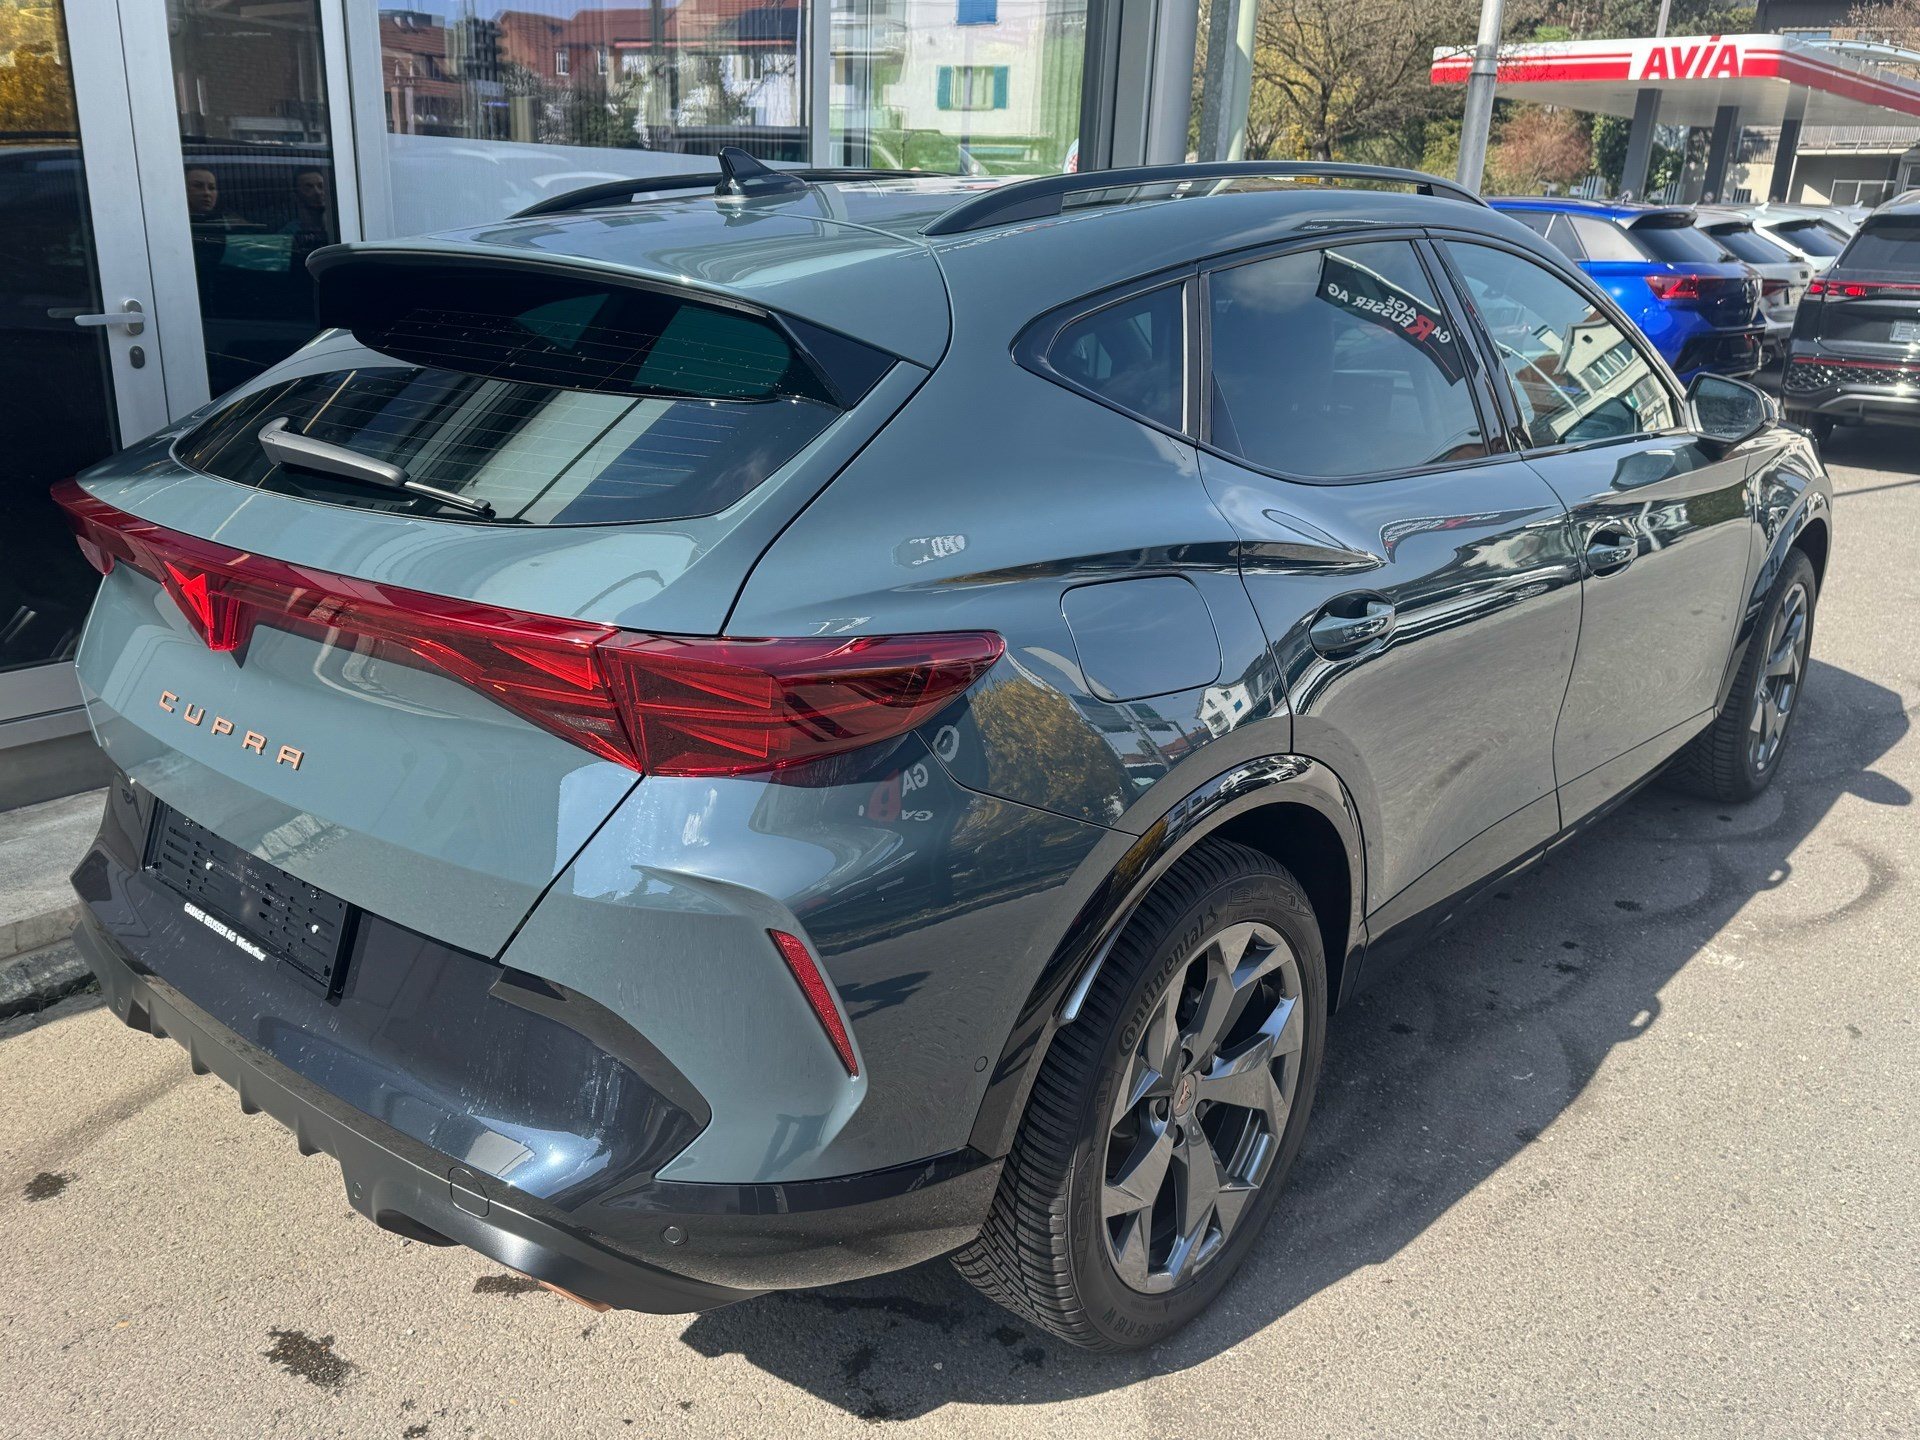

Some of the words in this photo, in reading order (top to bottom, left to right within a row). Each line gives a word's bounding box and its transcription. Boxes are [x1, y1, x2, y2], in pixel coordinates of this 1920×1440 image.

[1640, 34, 1740, 80] AVIA
[159, 690, 304, 771] CUPRA
[1119, 912, 1206, 1057] Continental
